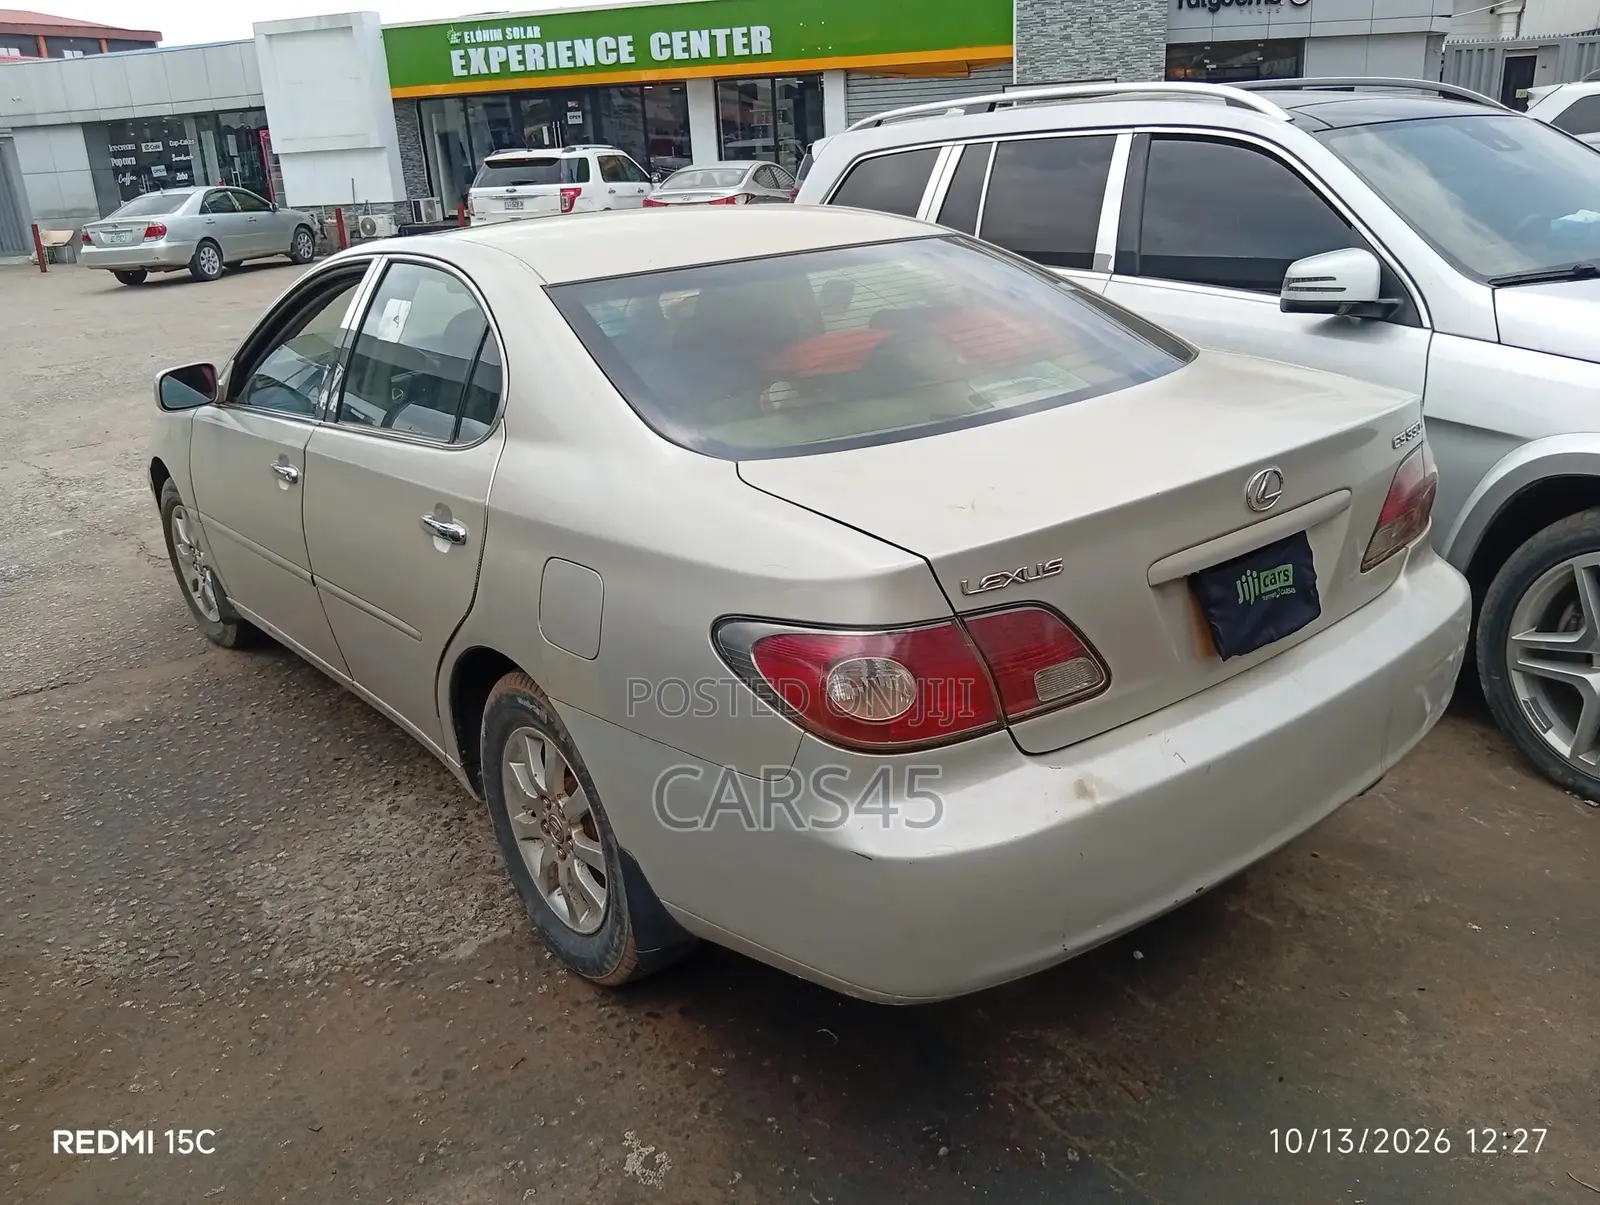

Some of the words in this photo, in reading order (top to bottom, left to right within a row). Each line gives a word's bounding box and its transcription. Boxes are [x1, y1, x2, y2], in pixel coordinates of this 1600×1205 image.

[464, 28, 503, 44] ELOHIM
[505, 26, 541, 40] SOLAR
[450, 35, 636, 77] EXPERIENCE
[650, 25, 773, 62] CENTER
[118, 172, 137, 186] Coffee
[961, 558, 1064, 596] LEXUS
